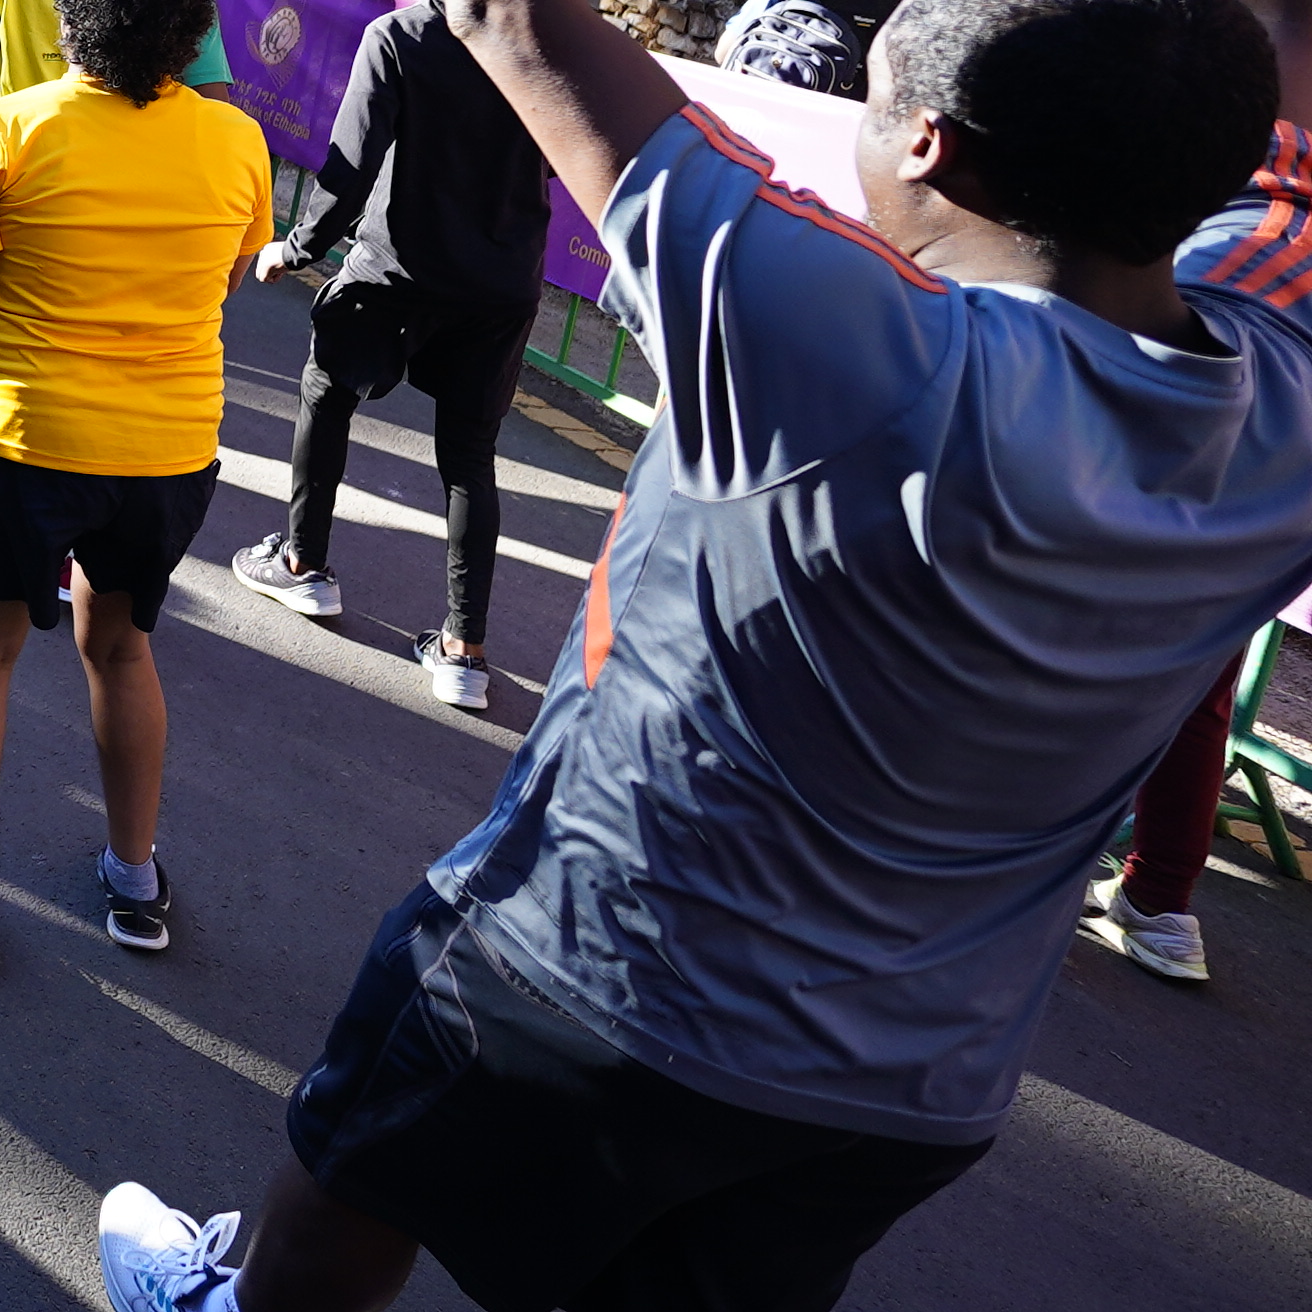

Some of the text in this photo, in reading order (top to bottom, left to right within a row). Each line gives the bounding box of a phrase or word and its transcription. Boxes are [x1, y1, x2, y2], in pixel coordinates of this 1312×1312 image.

[242, 99, 262, 120] Bank
[263, 110, 274, 123] of
[272, 112, 311, 140] Ethiopia
